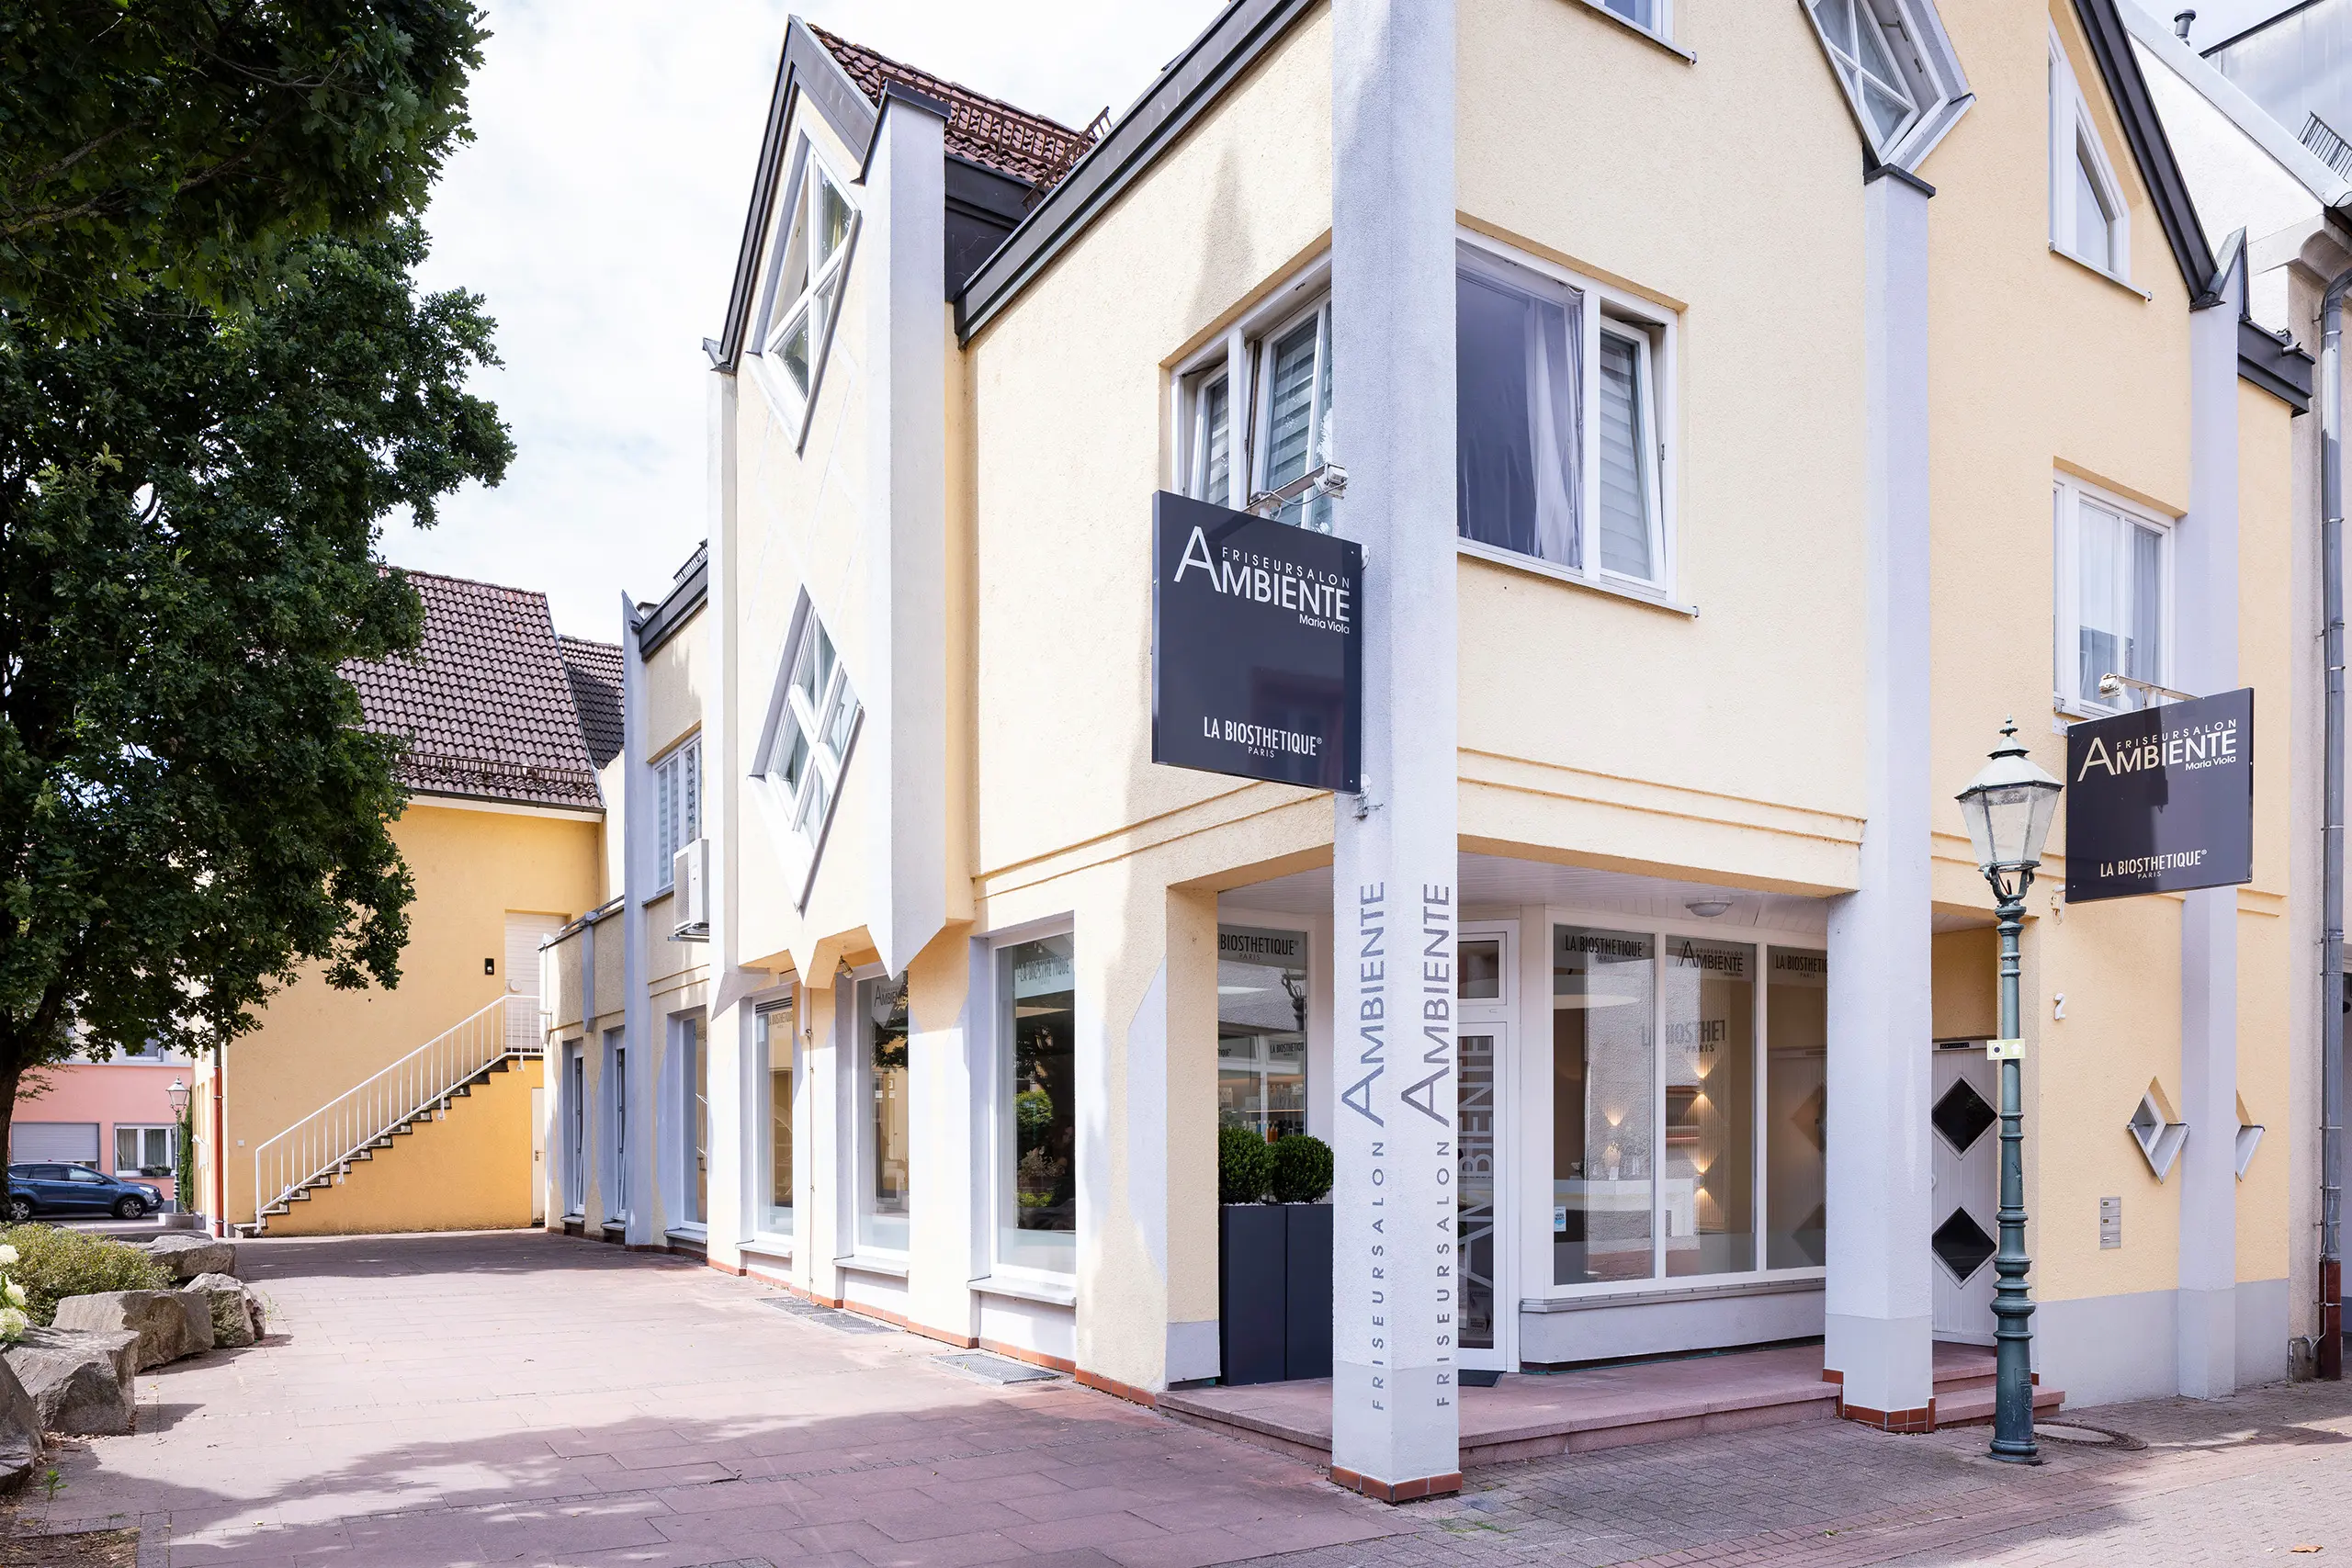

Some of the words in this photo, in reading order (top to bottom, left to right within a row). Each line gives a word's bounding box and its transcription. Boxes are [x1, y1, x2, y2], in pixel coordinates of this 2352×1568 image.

[1173, 525, 1351, 622] AMBIENTE
[1222, 547, 1351, 589] FRISEURSALON
[1299, 614, 1327, 629] Maria
[1328, 619, 1351, 635] Viola
[1204, 716, 1220, 739] LA
[2116, 718, 2237, 750] FRISEURSALON
[1248, 746, 1275, 759] PARIS
[2076, 728, 2237, 783] AMBIENTE
[2185, 760, 2211, 772] Maria
[2213, 755, 2237, 766] Viola
[2100, 863, 2114, 877] LA
[2137, 870, 2162, 880] PARIS
[1565, 935, 1577, 952] LA
[1679, 940, 1744, 972] AMBIENTE
[1238, 953, 1261, 961] PARIS
[1595, 954, 1614, 963] PARIS
[1775, 953, 1785, 970] LA
[1341, 881, 1385, 1128] AMBIENTE
[1400, 884, 1450, 1128] AMBIENTE
[2052, 992, 2066, 1021] 2
[1372, 1142, 1385, 1411] FRISEURSALON
[1436, 1141, 1450, 1406] FRISEURSALON
